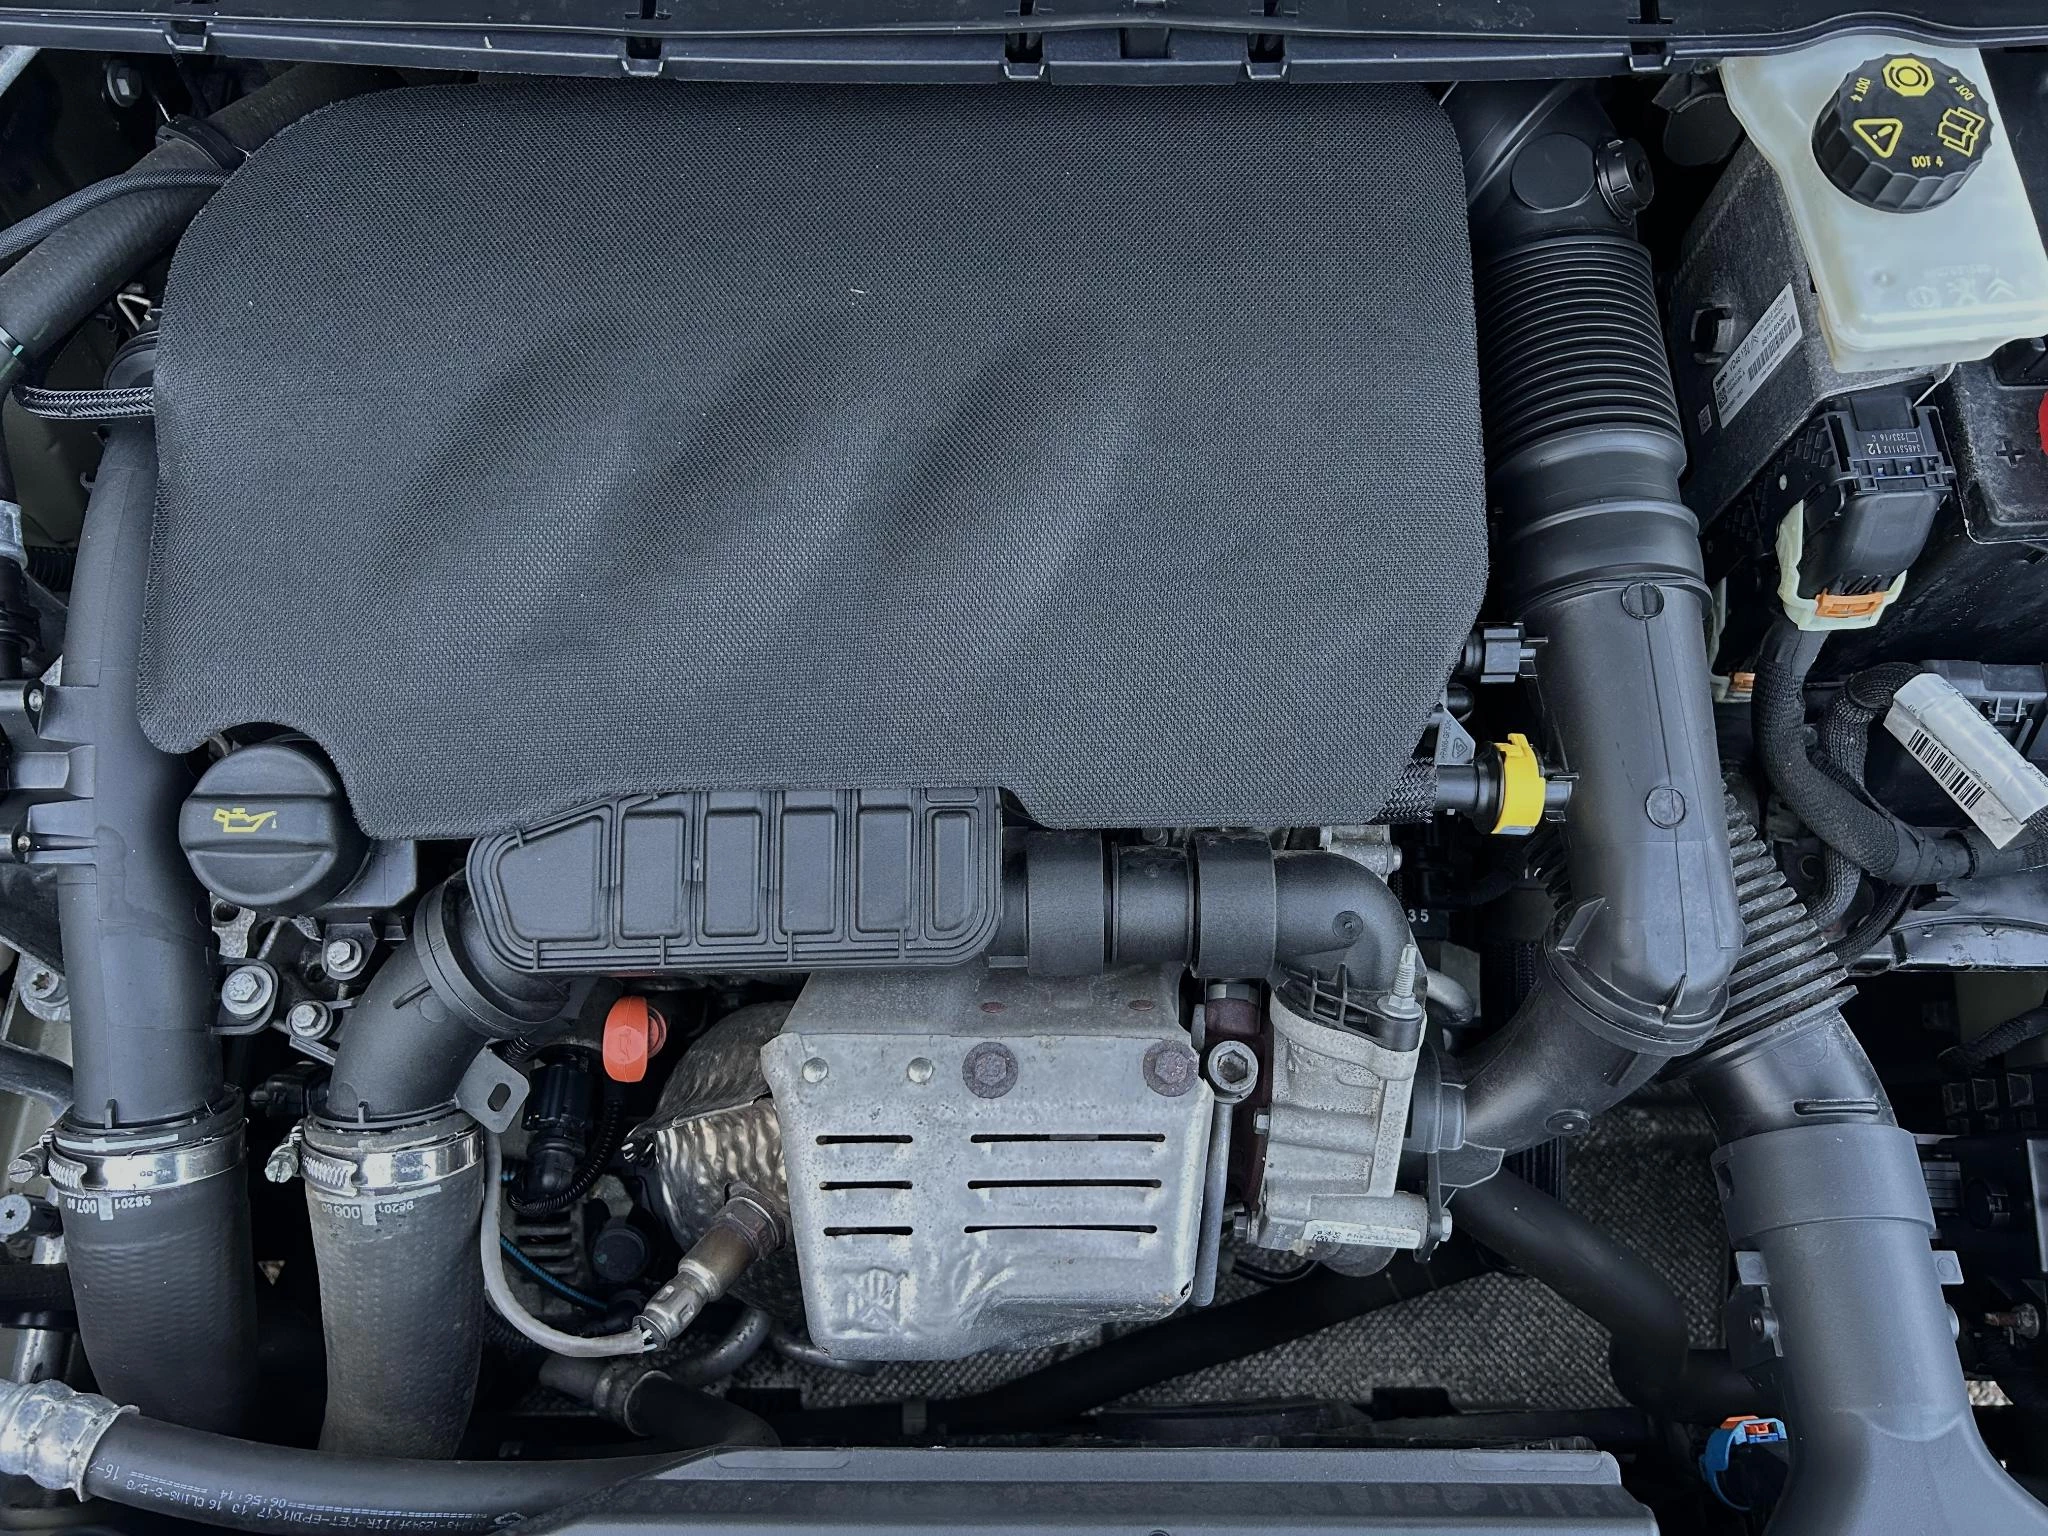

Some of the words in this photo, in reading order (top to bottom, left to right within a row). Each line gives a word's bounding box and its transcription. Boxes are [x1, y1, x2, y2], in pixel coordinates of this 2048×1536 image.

[1855, 77, 1871, 95] DOT
[1948, 76, 1958, 84] 4
[1849, 94, 1863, 103] 4
[1955, 84, 1975, 101] DOT
[1911, 155, 1931, 168] DOT
[1935, 155, 1944, 168] 4
[1407, 908, 1429, 923] 35
[114, 1195, 152, 1210] 98201
